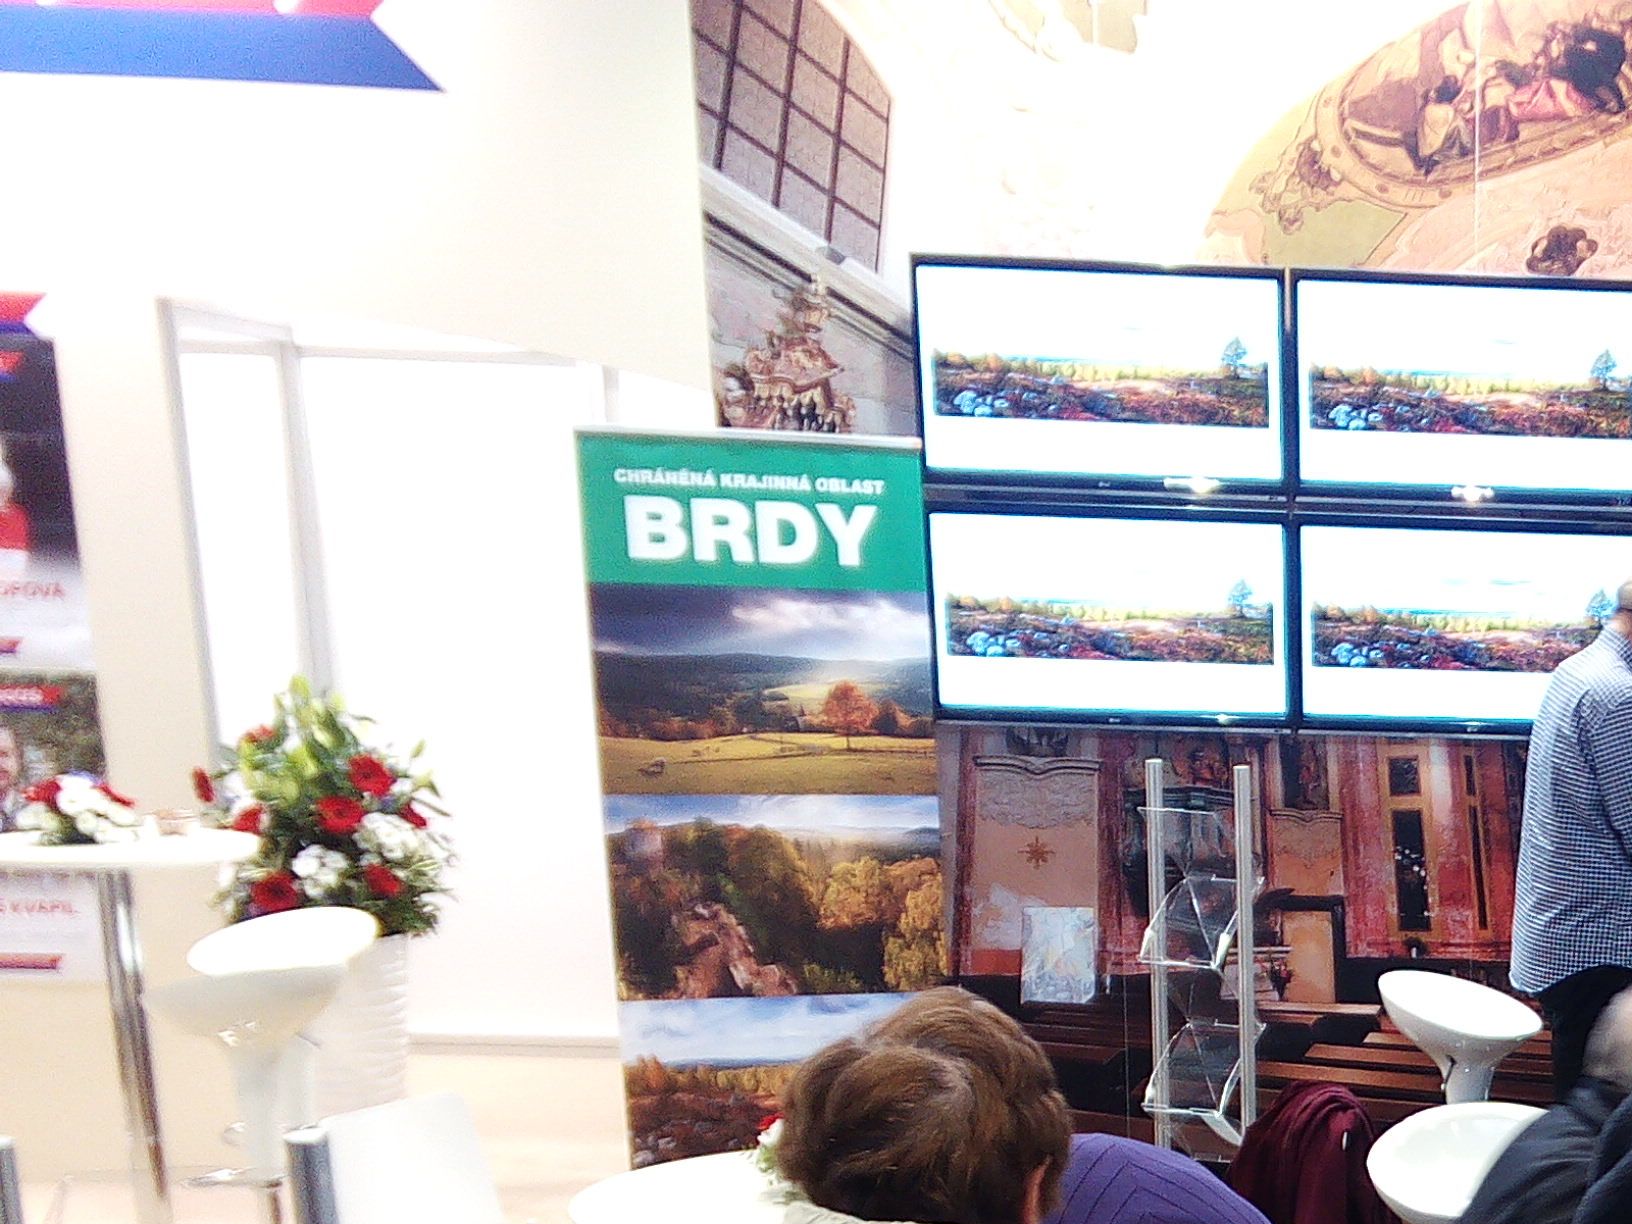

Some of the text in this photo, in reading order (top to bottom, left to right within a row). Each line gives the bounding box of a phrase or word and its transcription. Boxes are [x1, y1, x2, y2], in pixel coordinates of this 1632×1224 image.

[613, 467, 885, 495] CHRÁNĚNÁ KRAJINNÁ OBLAST
[623, 495, 878, 567] BRDY
